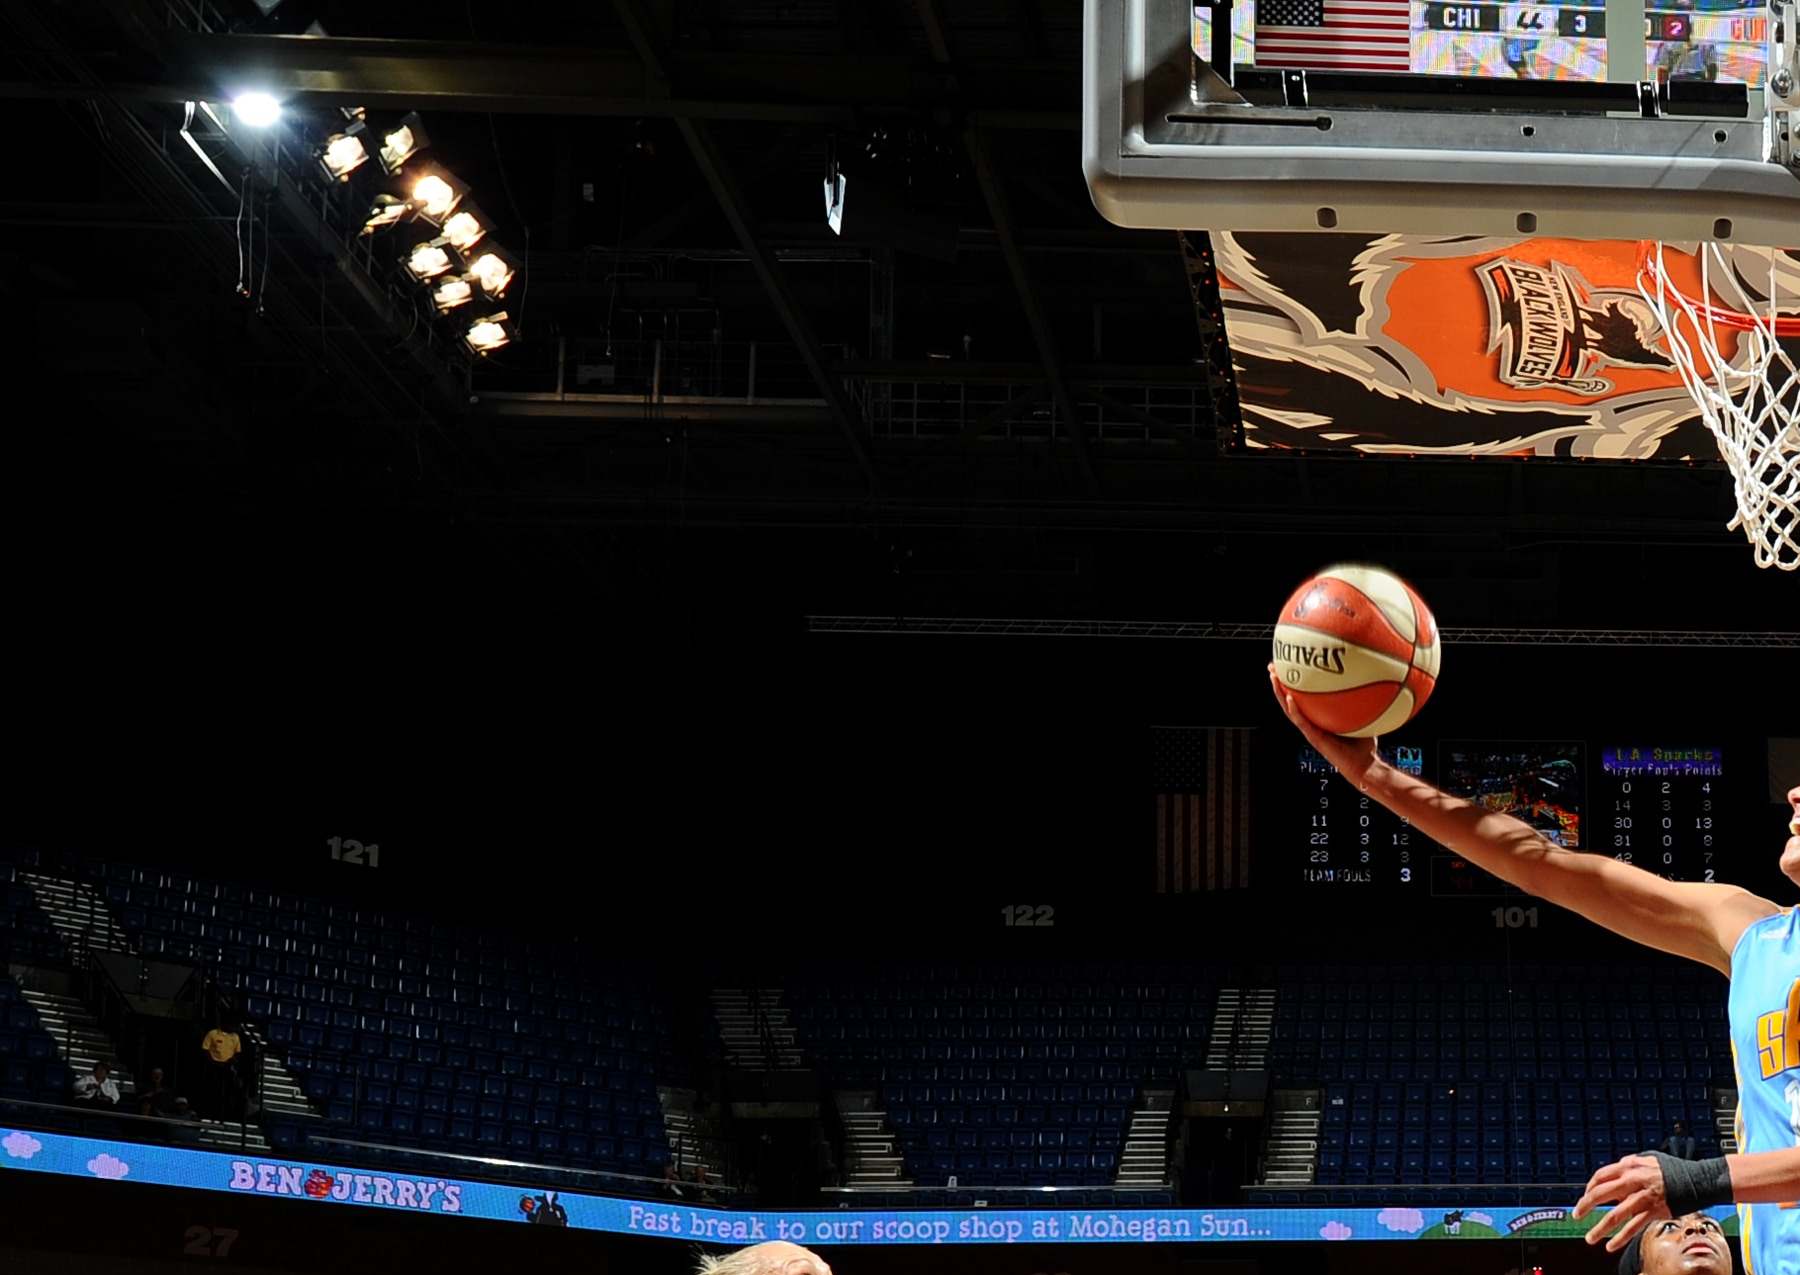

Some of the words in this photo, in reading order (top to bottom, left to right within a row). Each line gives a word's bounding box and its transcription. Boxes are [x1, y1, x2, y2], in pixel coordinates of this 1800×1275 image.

[1442, 7, 1482, 28] CHI
[1575, 15, 1587, 33] 3
[1684, 763, 1724, 777] Points
[1319, 778, 1329, 792] 7
[1622, 781, 1632, 793] 0
[1661, 781, 1671, 794] 2
[1702, 782, 1711, 793] 4
[1319, 796, 1329, 809] 9
[1359, 797, 1369, 809] 2
[1615, 799, 1632, 812] 14
[1662, 799, 1672, 811] 3
[1703, 799, 1712, 811] 3
[1312, 814, 1328, 827] 11
[1359, 815, 1369, 827] 0
[1614, 817, 1633, 829] 30
[1662, 817, 1672, 829] 0
[1695, 817, 1713, 830] 13
[1310, 832, 1329, 845] 22
[1360, 833, 1370, 845] 3
[1392, 833, 1410, 846] 12
[1614, 834, 1632, 847] 31
[1662, 834, 1673, 847] 0
[326, 835, 380, 868] 121
[1310, 850, 1329, 863] 23
[1360, 851, 1370, 863] 3
[1400, 851, 1410, 863] 3
[1614, 852, 1633, 865] 42
[1663, 852, 1673, 865] 0
[1703, 852, 1714, 865] 7
[1303, 868, 1334, 883] TEAM
[1336, 868, 1372, 883] FOULS
[1400, 867, 1412, 883] 3
[1704, 868, 1716, 883] 2
[1000, 904, 1055, 927] 122
[1490, 905, 1539, 929] 101
[229, 1160, 303, 1195] BEN
[332, 1171, 463, 1213] JERRY'S
[628, 1205, 682, 1233] Fast
[690, 1208, 766, 1240] break
[776, 1218, 806, 1240] to
[815, 1220, 864, 1240] our
[872, 1219, 950, 1243] scoop
[958, 1214, 1023, 1243] shop
[1031, 1218, 1060, 1239] at
[1068, 1213, 1192, 1241] Mohegan
[1199, 1212, 1272, 1238] Sun...
[183, 1224, 240, 1257] 27
